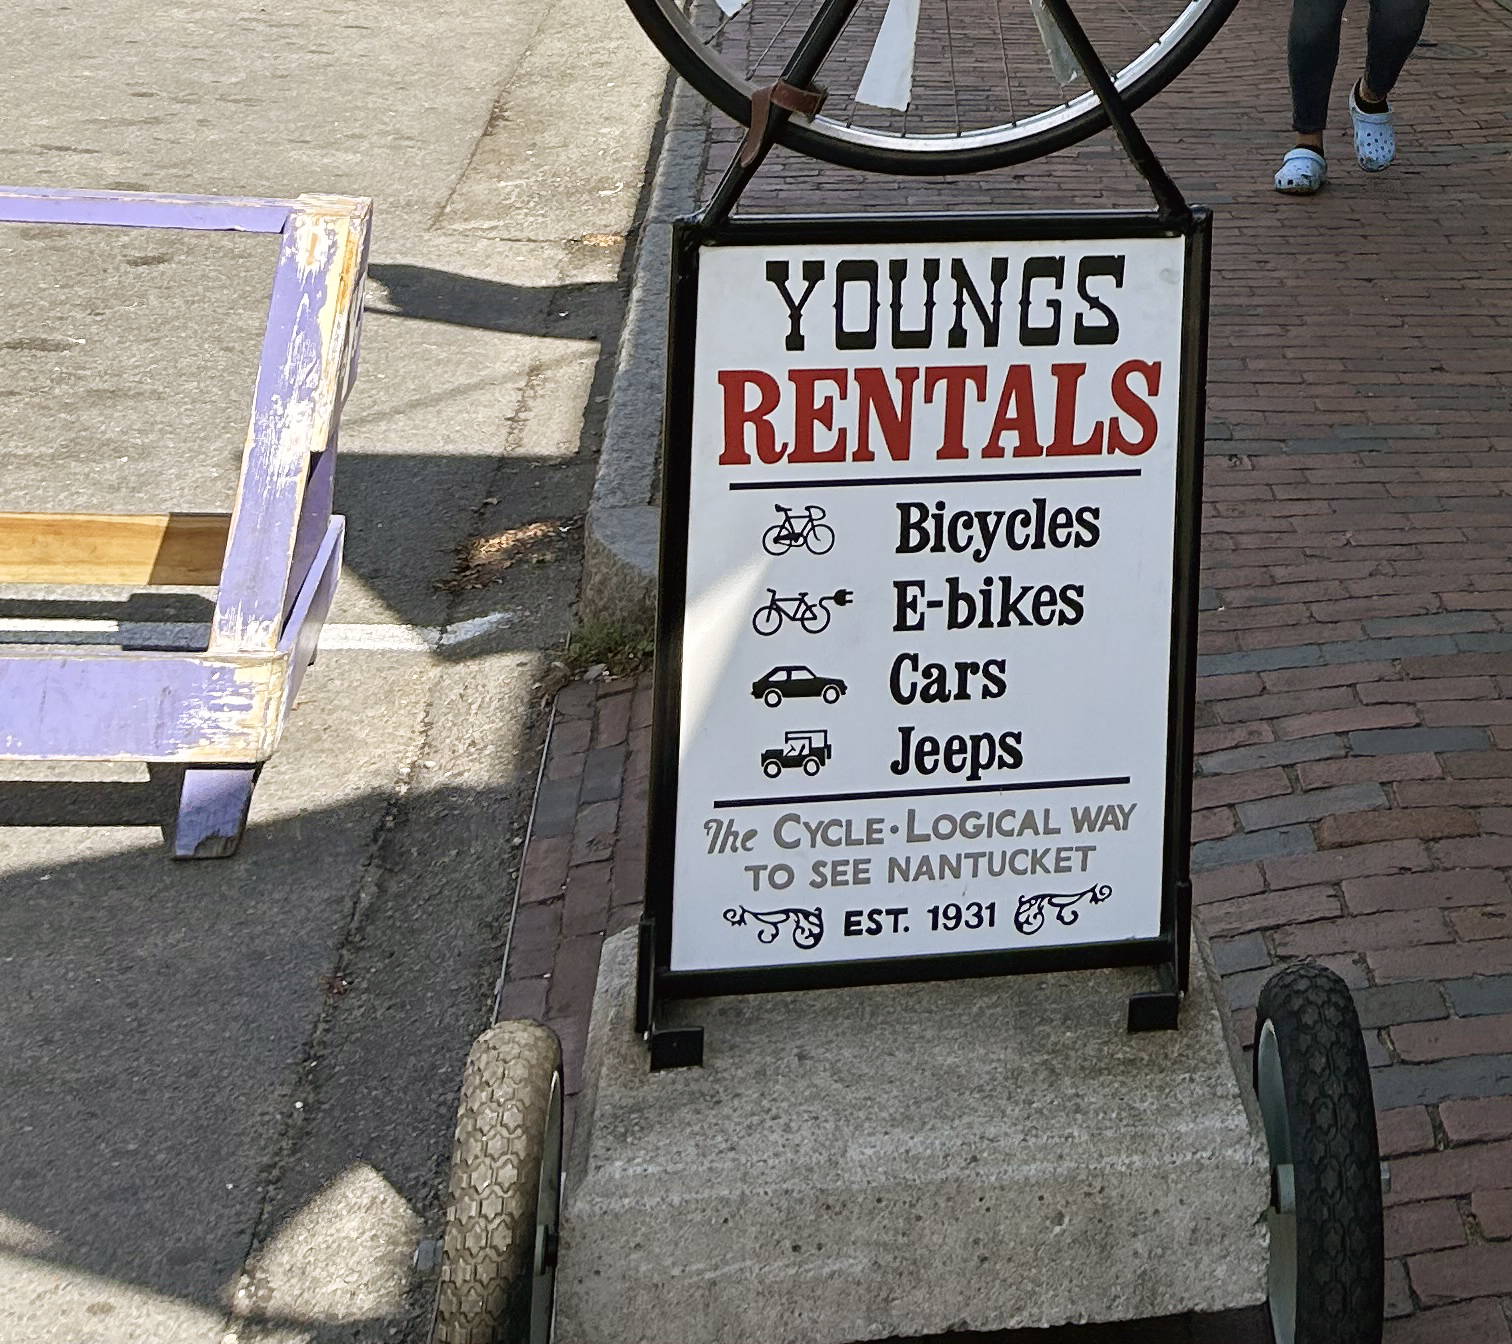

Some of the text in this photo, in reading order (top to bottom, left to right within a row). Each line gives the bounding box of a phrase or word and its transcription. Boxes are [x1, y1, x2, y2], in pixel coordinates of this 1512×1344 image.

[766, 254, 1126, 351] YOUNGS
[718, 360, 1161, 466] RENTALS
[895, 498, 1101, 563] Bicycles
[893, 575, 1085, 631] E-bikes
[889, 653, 1008, 705] Cars
[891, 725, 1023, 781] Jeeps
[704, 818, 758, 854] The
[1071, 803, 1137, 833] WAY
[744, 845, 1096, 891] TO SEE NANTUCKET
[843, 902, 996, 936] EST. 1931
